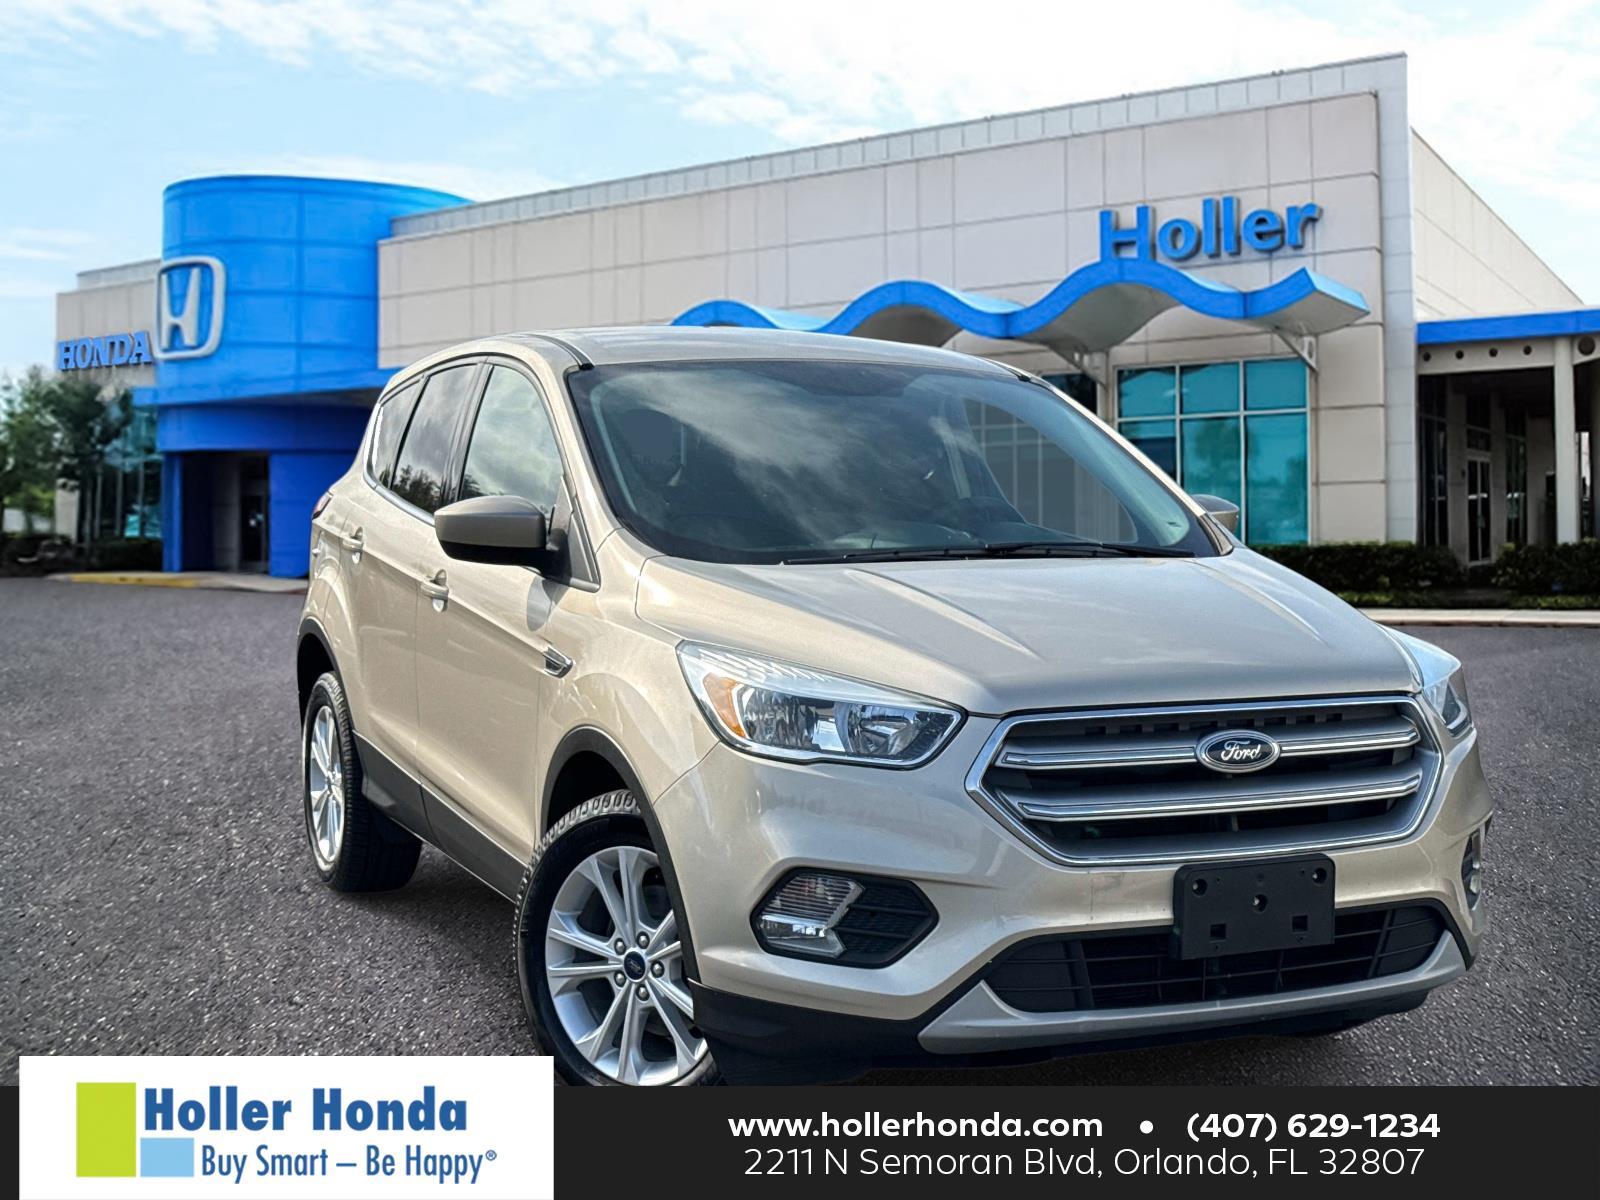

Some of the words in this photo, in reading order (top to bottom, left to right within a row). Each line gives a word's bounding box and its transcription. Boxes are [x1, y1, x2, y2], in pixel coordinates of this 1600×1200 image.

[1099, 196, 1322, 262] Holler
[57, 331, 152, 371] HONDA
[1220, 740, 1262, 761] Ford
